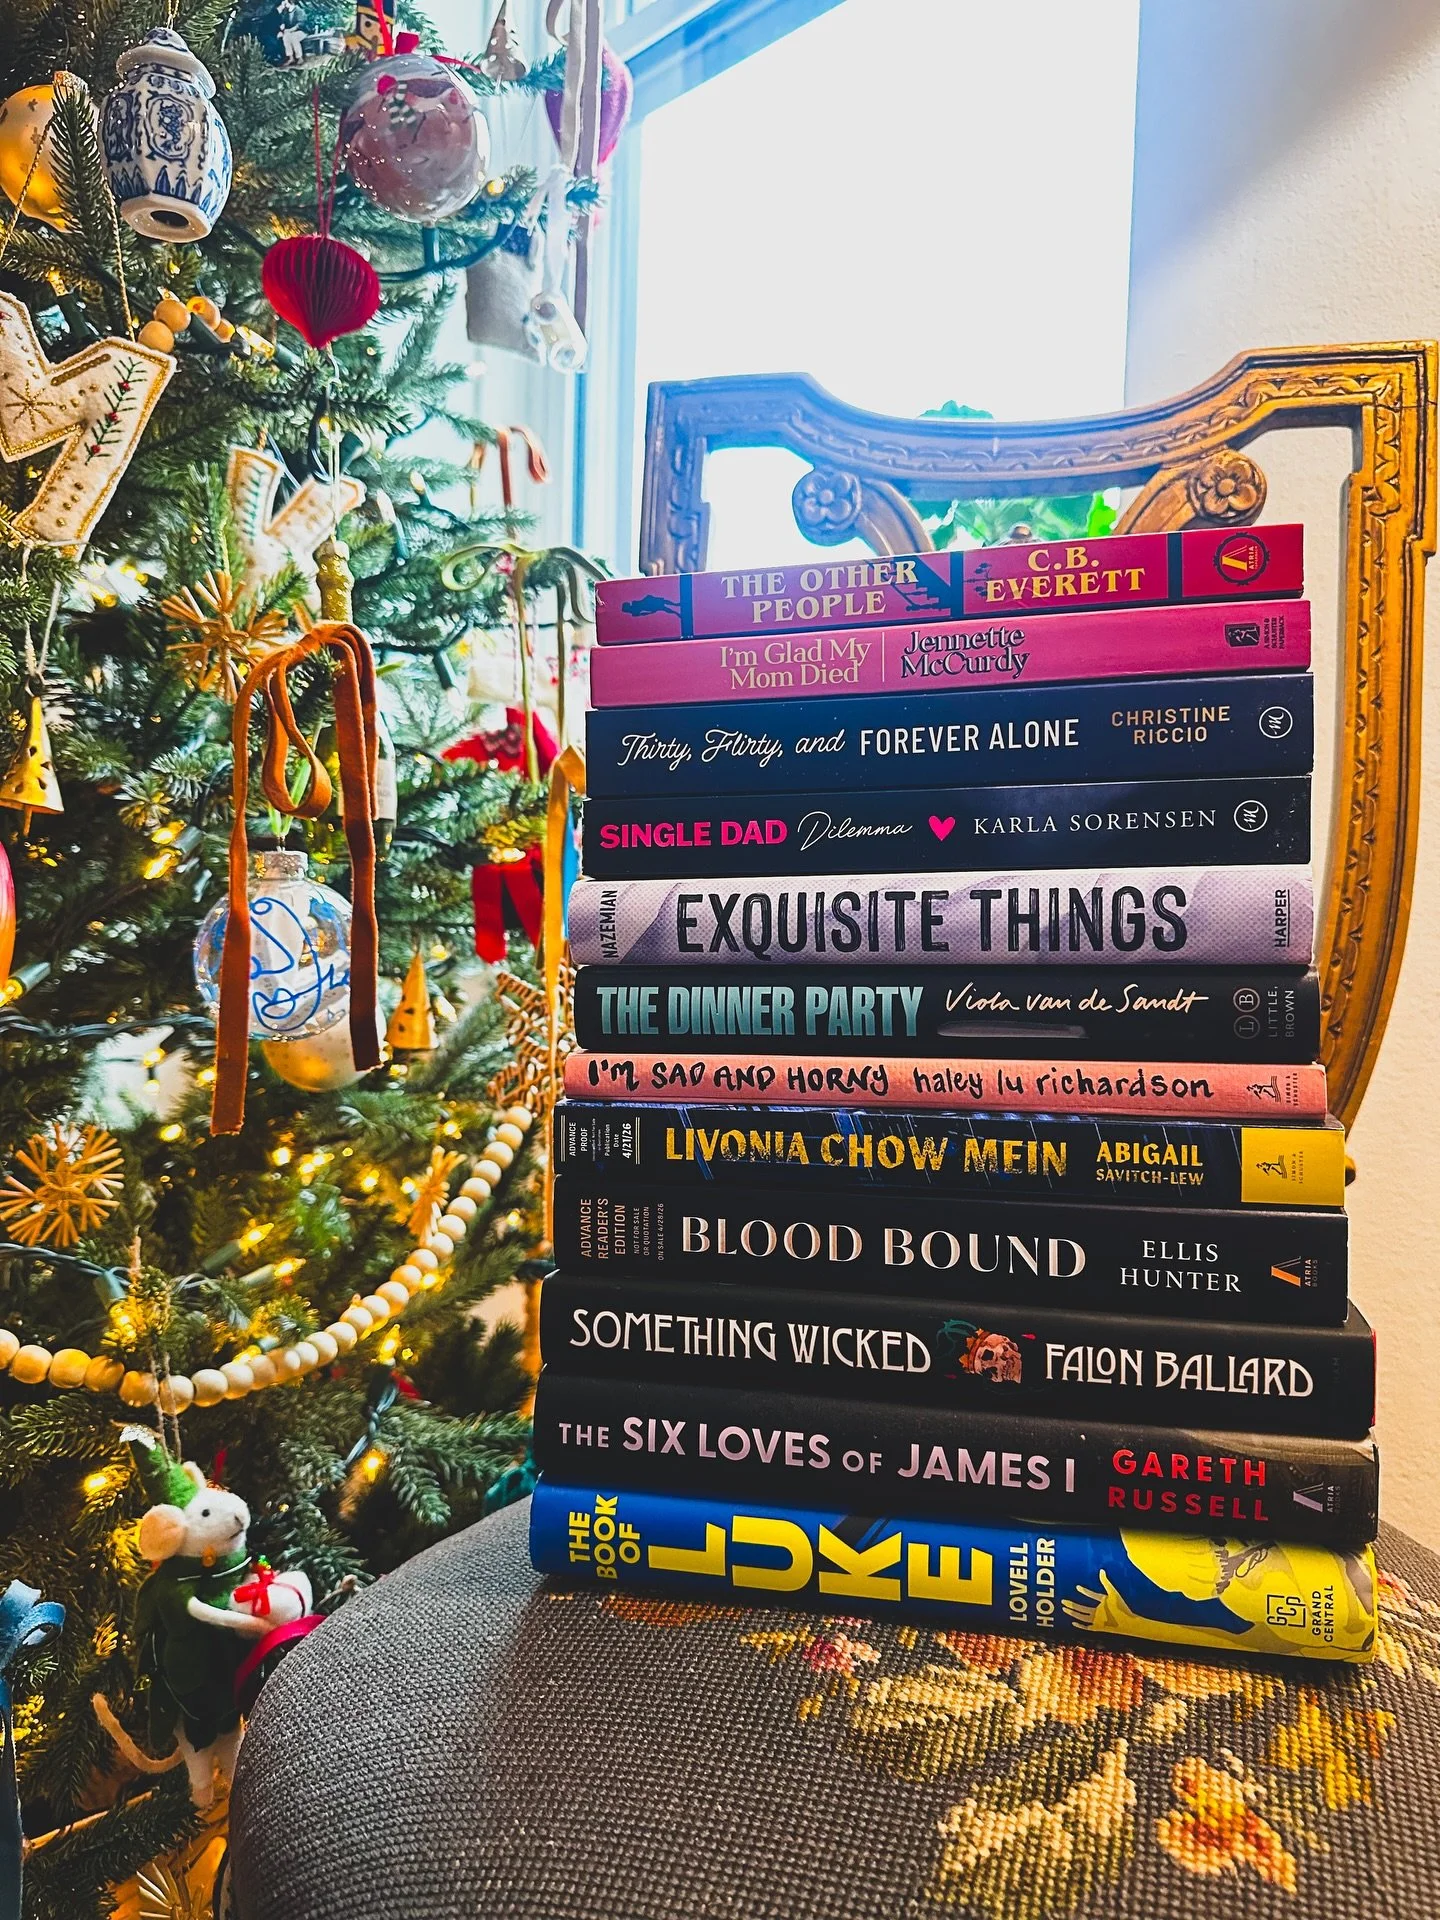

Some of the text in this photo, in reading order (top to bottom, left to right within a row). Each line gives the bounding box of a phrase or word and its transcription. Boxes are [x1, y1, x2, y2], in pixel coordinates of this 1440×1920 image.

[721, 560, 919, 600] THE OTHER
[1028, 545, 1100, 573] C.B.
[985, 567, 1146, 603] EVERETT
[752, 590, 887, 624] PEOPLE
[719, 637, 872, 668] I'm Glad My
[904, 626, 1025, 655] Jennette
[730, 659, 859, 690] Mom Died
[900, 646, 1030, 679] McCurdy
[1111, 705, 1231, 727] CHRISTINE
[1133, 726, 1208, 745] RICCIO
[617, 718, 1080, 771] Thirty, Flirty, and FOREVER ALONE
[600, 810, 913, 852] SINGLE DAD Dilemma
[974, 809, 1217, 835] KARLA SORENSEN
[600, 889, 618, 958] NAZEMIAN
[676, 885, 1188, 961] EXQUISITE THINGS
[1274, 888, 1287, 948] HARPER
[596, 986, 924, 1037] THE DINNER PARTY
[945, 981, 1209, 1014] Viola van de Sandt
[1267, 986, 1278, 1037] LITTLE,
[1285, 990, 1295, 1037] BROWN
[587, 1059, 890, 1096] I'M SAD AND HORNY
[913, 1067, 1214, 1100] haley lu richardson
[569, 1122, 577, 1157] ADVANCE
[580, 1127, 588, 1152] PROOF
[621, 1122, 633, 1159] 4/21/26
[665, 1126, 1067, 1177] LIVONIA CHOW MEIN
[1096, 1141, 1204, 1168] ABIGAIL
[1096, 1168, 1204, 1186] SAVITCH-LEW
[580, 1199, 592, 1258] ADVANCE
[597, 1198, 609, 1259] READER'S
[614, 1204, 626, 1255] EDITION
[643, 1206, 651, 1256] OR QUOTATION
[682, 1215, 1086, 1279] BLOOD BOUND
[657, 1250, 664, 1261] ON
[1142, 1239, 1219, 1264] ELLIS
[1120, 1267, 1242, 1294] HUNTER
[569, 1307, 932, 1374] SOMETHING WICKED
[1045, 1342, 1143, 1387] FALON
[1155, 1350, 1314, 1398] BALLARD
[558, 1416, 1075, 1493] THE SIX LOVES OF JAMES I
[1112, 1448, 1267, 1487] GARETH
[1108, 1485, 1269, 1522] RUSSELL
[568, 1511, 590, 1563] THE
[593, 1494, 619, 1580] BOOK
[619, 1522, 641, 1565] OF
[647, 1514, 993, 1606] LUKE
[1009, 1542, 1028, 1622] LOVELL
[1035, 1537, 1056, 1628] HOLDER
[1312, 1590, 1321, 1636] GRAND
[1324, 1585, 1334, 1642] CENTRAL
